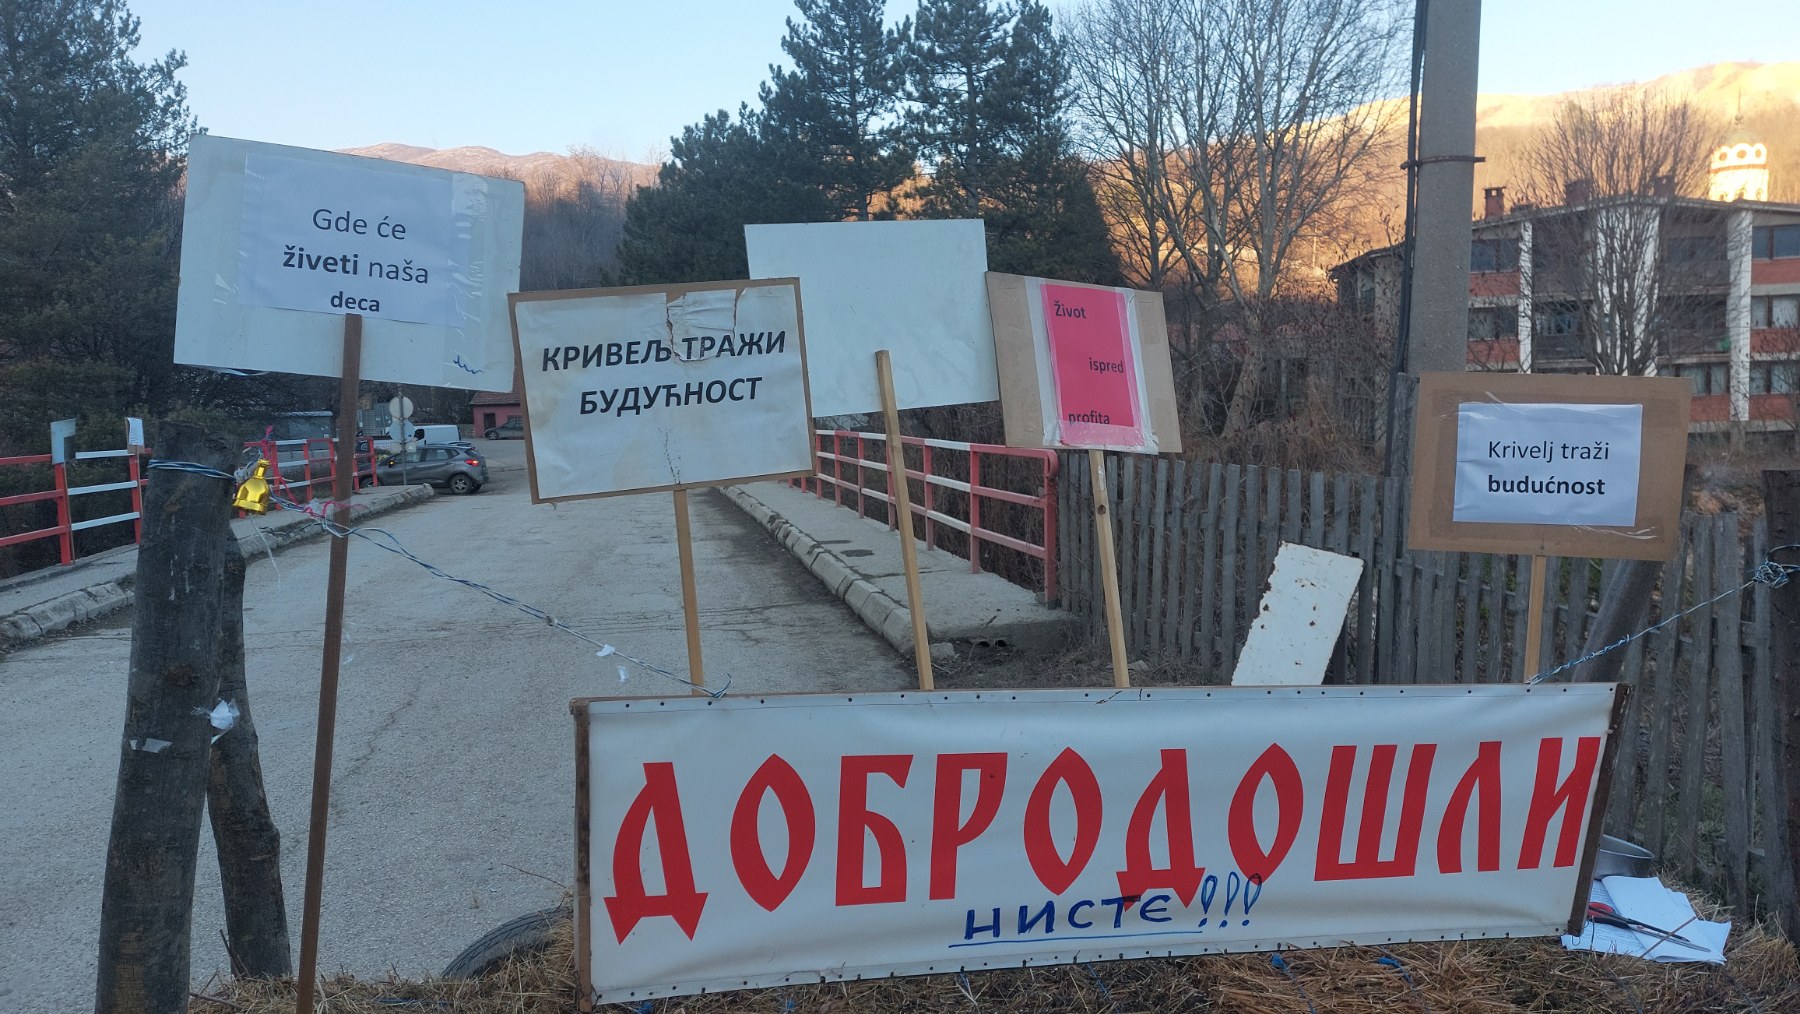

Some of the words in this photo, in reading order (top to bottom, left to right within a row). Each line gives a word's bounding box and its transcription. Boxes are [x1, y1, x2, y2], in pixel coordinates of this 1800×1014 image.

[312, 208, 367, 234] Gde
[376, 215, 406, 240] će
[282, 244, 358, 275] živeti
[368, 258, 429, 284] naša
[330, 291, 380, 312] deca
[1053, 299, 1086, 319] Život
[542, 339, 672, 372] КРИВЕЉ
[681, 330, 786, 360] ТРАЖИ
[1088, 357, 1124, 375] ispred
[579, 377, 762, 417] БУДУЋНОСТ
[1068, 410, 1110, 426] profita
[1488, 440, 1554, 463] Krivelj
[1561, 441, 1609, 460] traži
[1488, 474, 1606, 495] budućnost
[603, 737, 1601, 946] ДОБРОДОШЛИ
